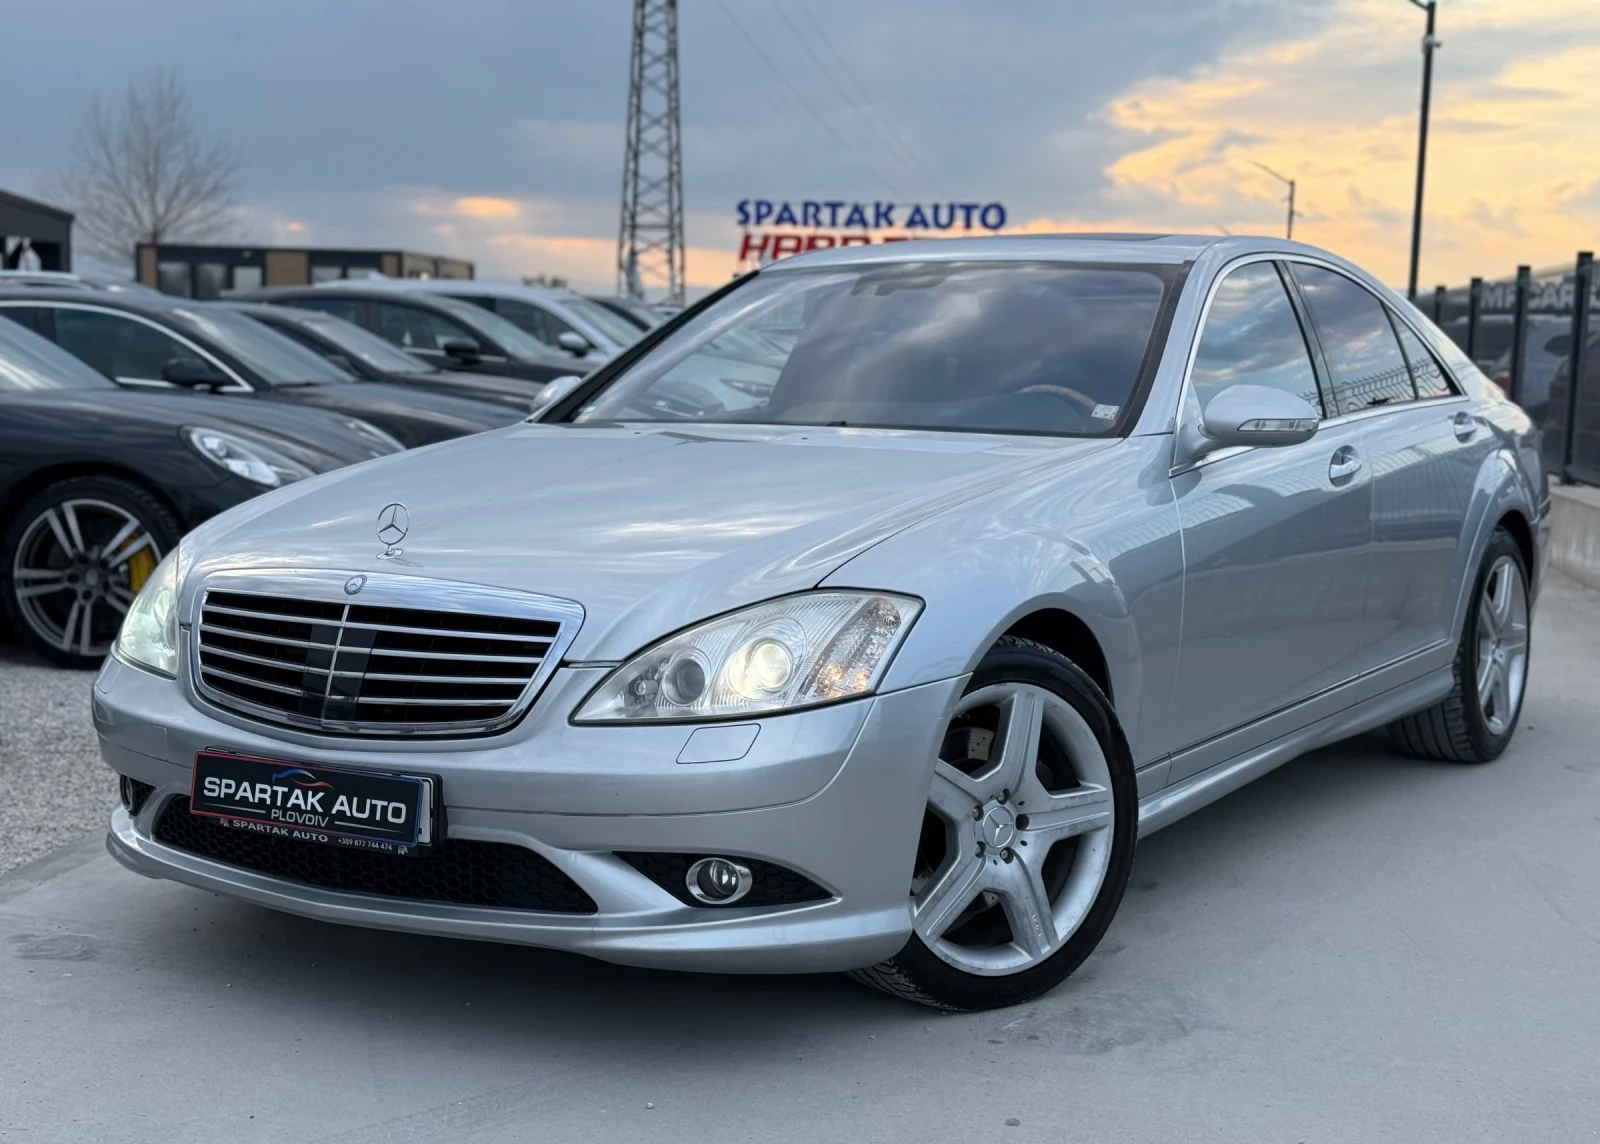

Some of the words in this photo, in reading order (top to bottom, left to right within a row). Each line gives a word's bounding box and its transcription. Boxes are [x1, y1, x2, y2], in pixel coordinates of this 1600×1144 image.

[735, 200, 896, 229] SPARTAK
[906, 202, 1007, 230] AUTO
[203, 777, 326, 813] SPARTAK
[331, 795, 407, 824] AUTO
[271, 809, 329, 827] PLOVDIV
[233, 819, 289, 837] SPARTAK
[292, 830, 329, 843] AUTO
[337, 837, 354, 846] +359
[367, 841, 380, 850] 744
[380, 842, 393, 851] 474
